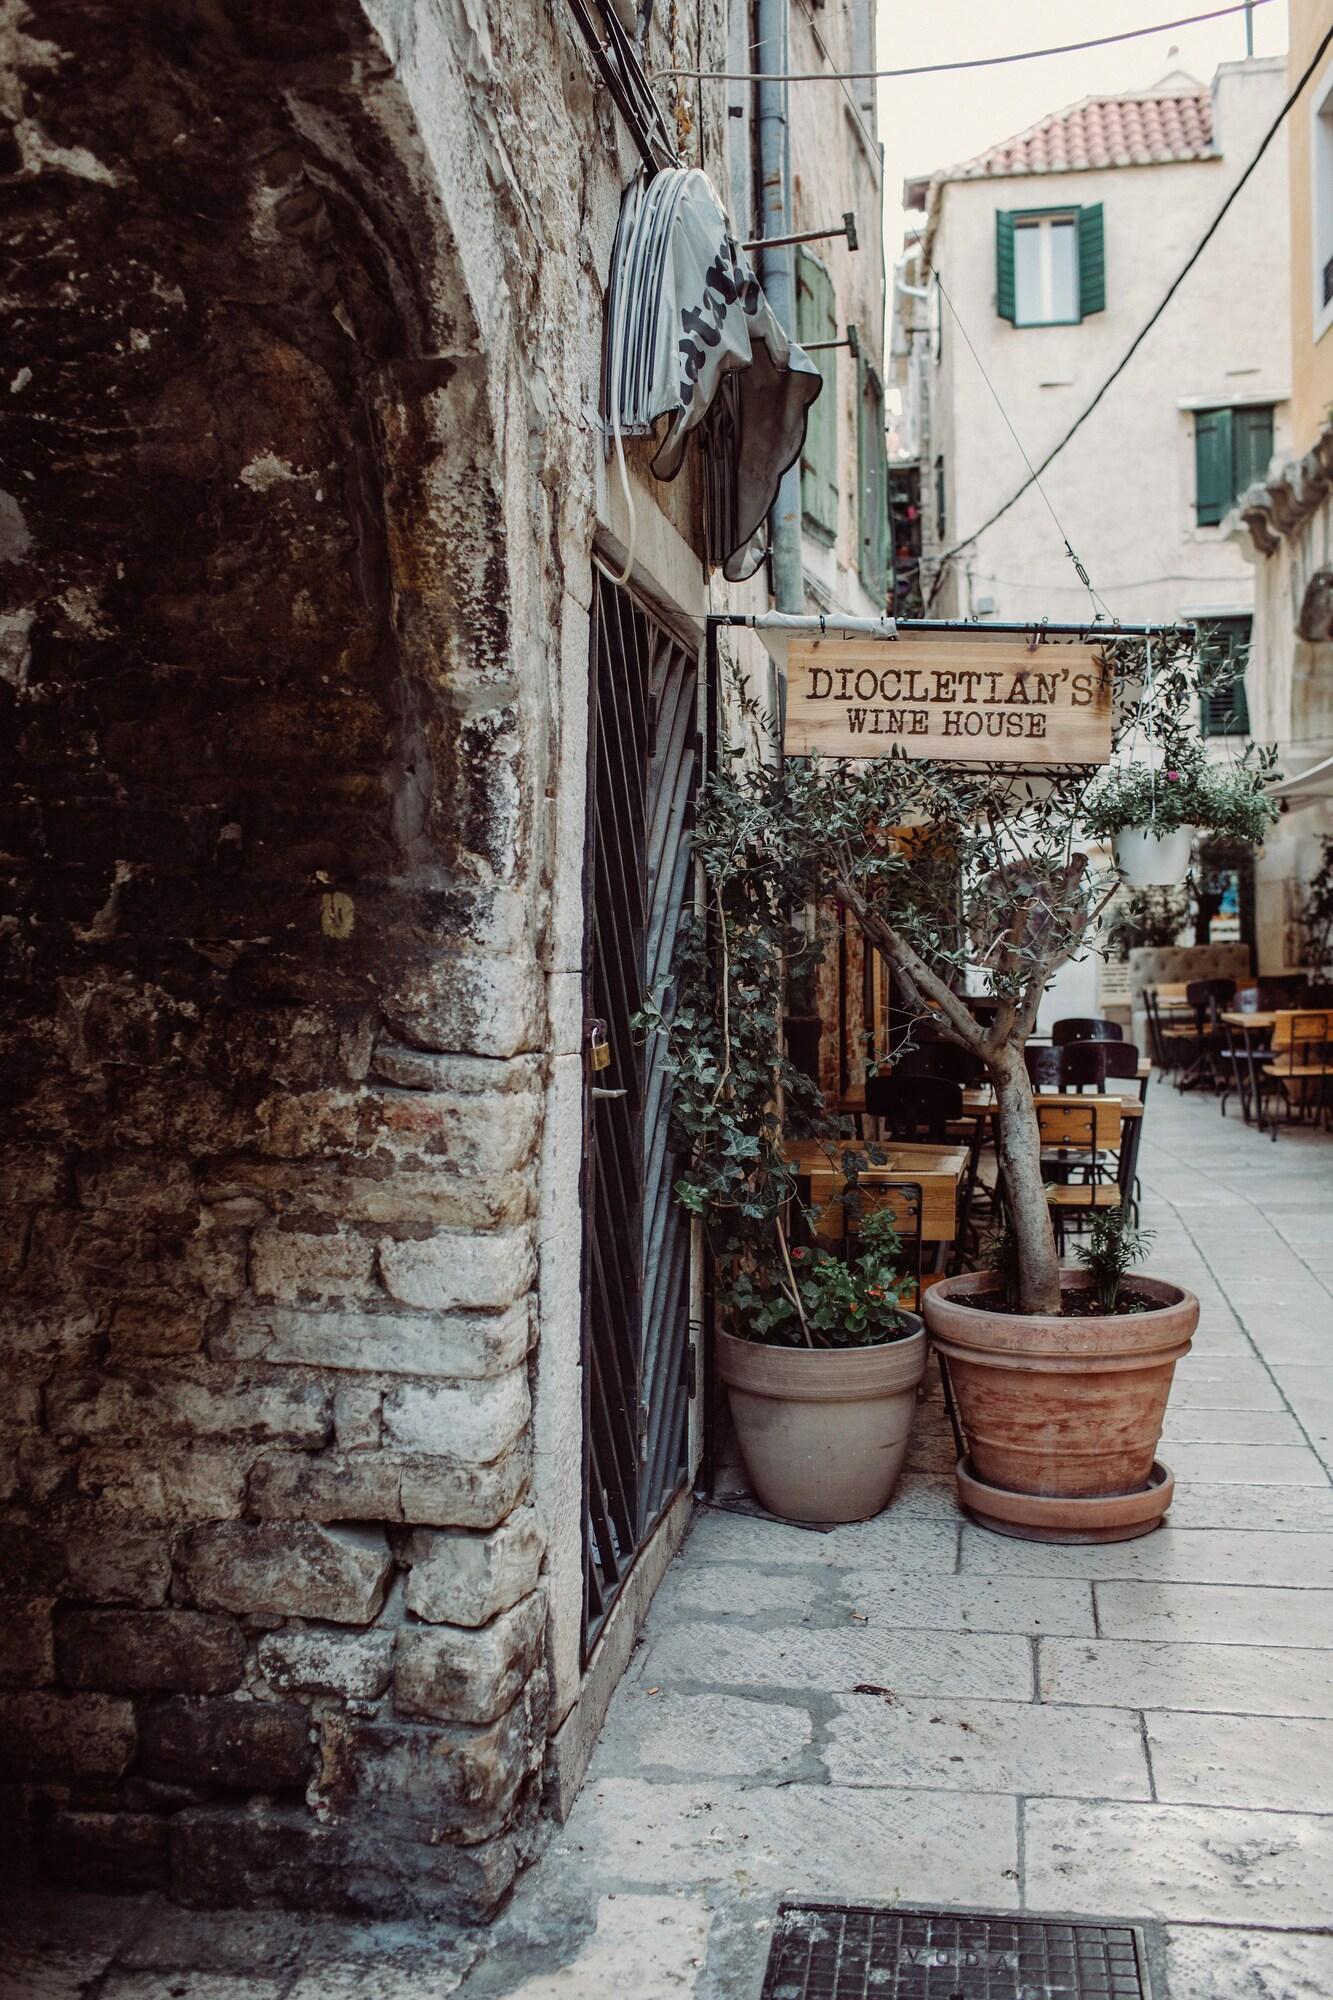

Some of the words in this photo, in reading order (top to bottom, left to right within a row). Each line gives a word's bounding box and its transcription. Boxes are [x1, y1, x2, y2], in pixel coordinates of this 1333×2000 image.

[806, 667, 1093, 707] DIOCLETIAN'S
[846, 708, 929, 736] WINE
[942, 710, 1047, 738] HOUSE
